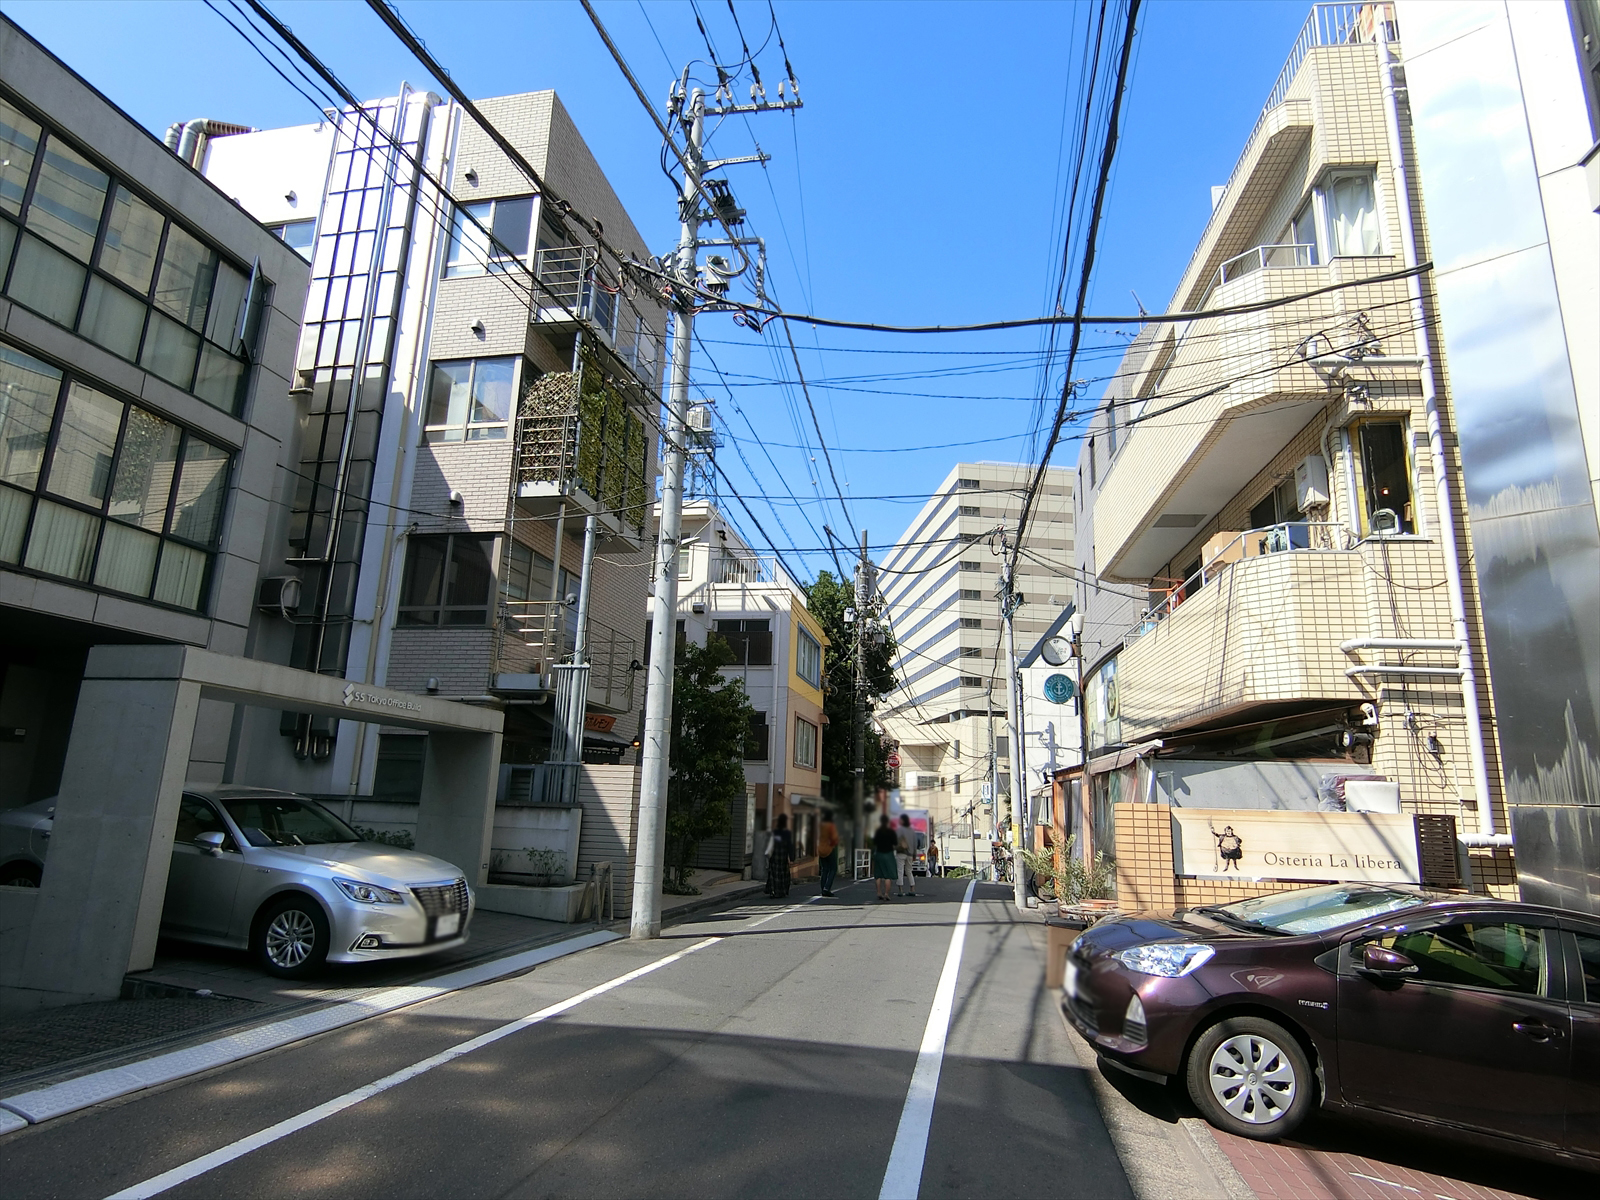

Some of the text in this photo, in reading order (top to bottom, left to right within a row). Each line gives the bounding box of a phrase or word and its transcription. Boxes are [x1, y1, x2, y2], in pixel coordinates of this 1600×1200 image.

[354, 691, 365, 702] SS
[367, 693, 386, 706] Tokyo
[387, 697, 407, 709] Office
[1264, 851, 1402, 870] Osteria La libera
